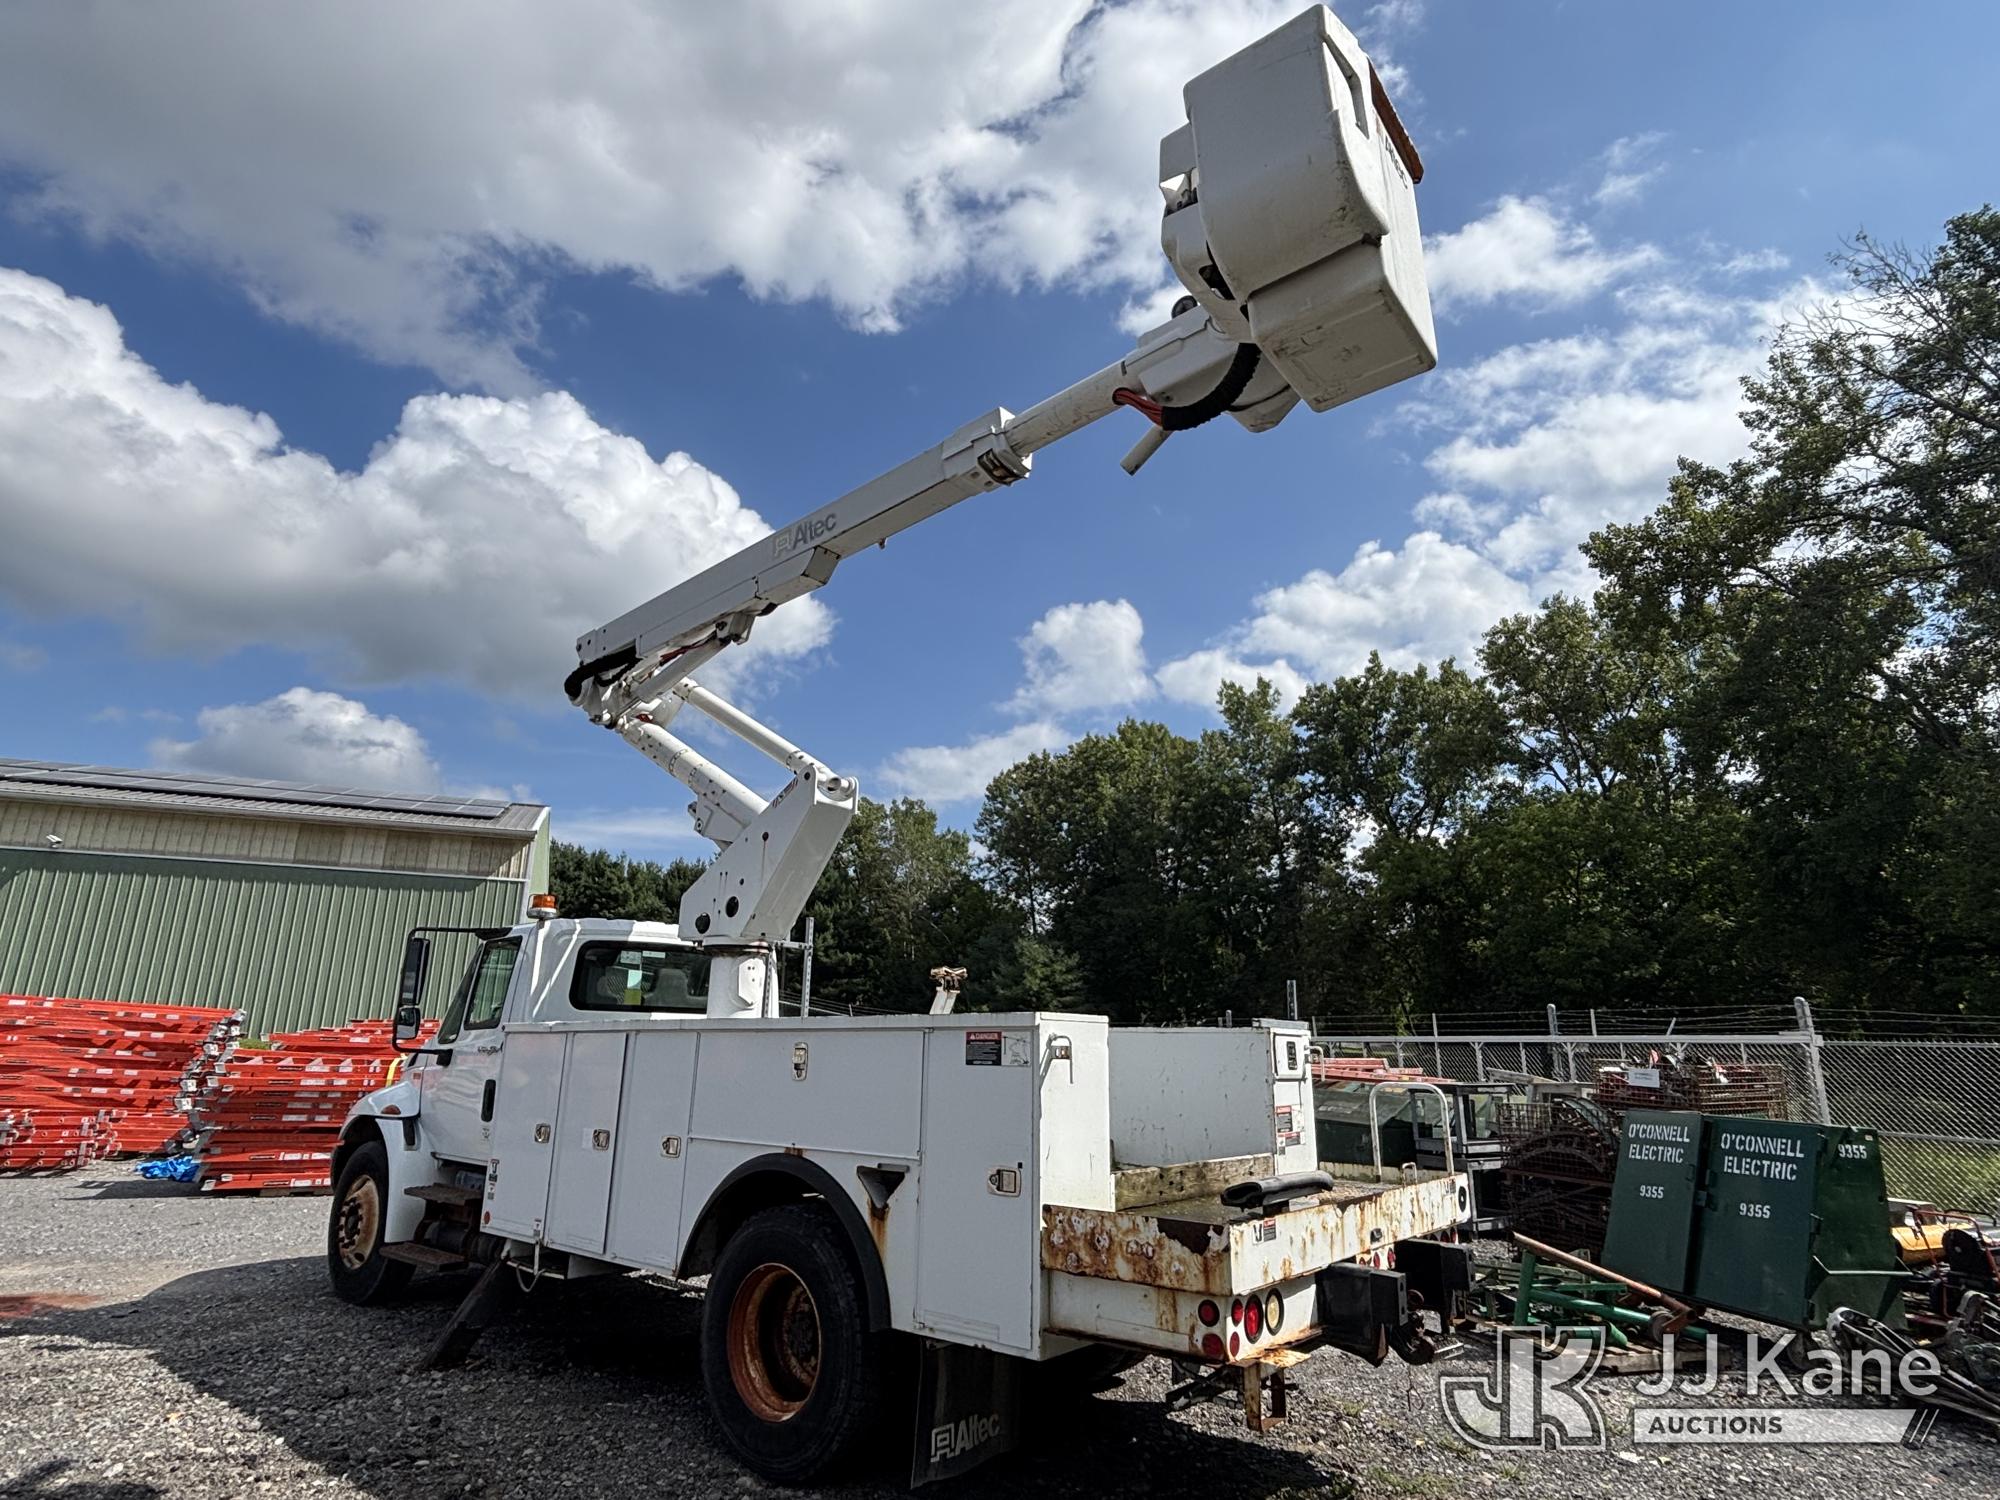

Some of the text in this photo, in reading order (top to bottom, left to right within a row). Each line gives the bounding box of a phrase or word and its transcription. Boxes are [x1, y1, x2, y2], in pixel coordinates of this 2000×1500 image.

[793, 513, 837, 550] Altec
[1628, 1123, 1690, 1143] O'CONNELL
[1628, 1143, 1684, 1164] ELECTRIC
[1720, 1132, 1805, 1158] O'CONNELL
[1837, 1143, 1868, 1160] 9355
[1723, 1156, 1798, 1181] ELECTRIC
[1639, 1184, 1665, 1199] 9355
[1739, 1202, 1771, 1219] 9355
[955, 1414, 1000, 1456] Altec
